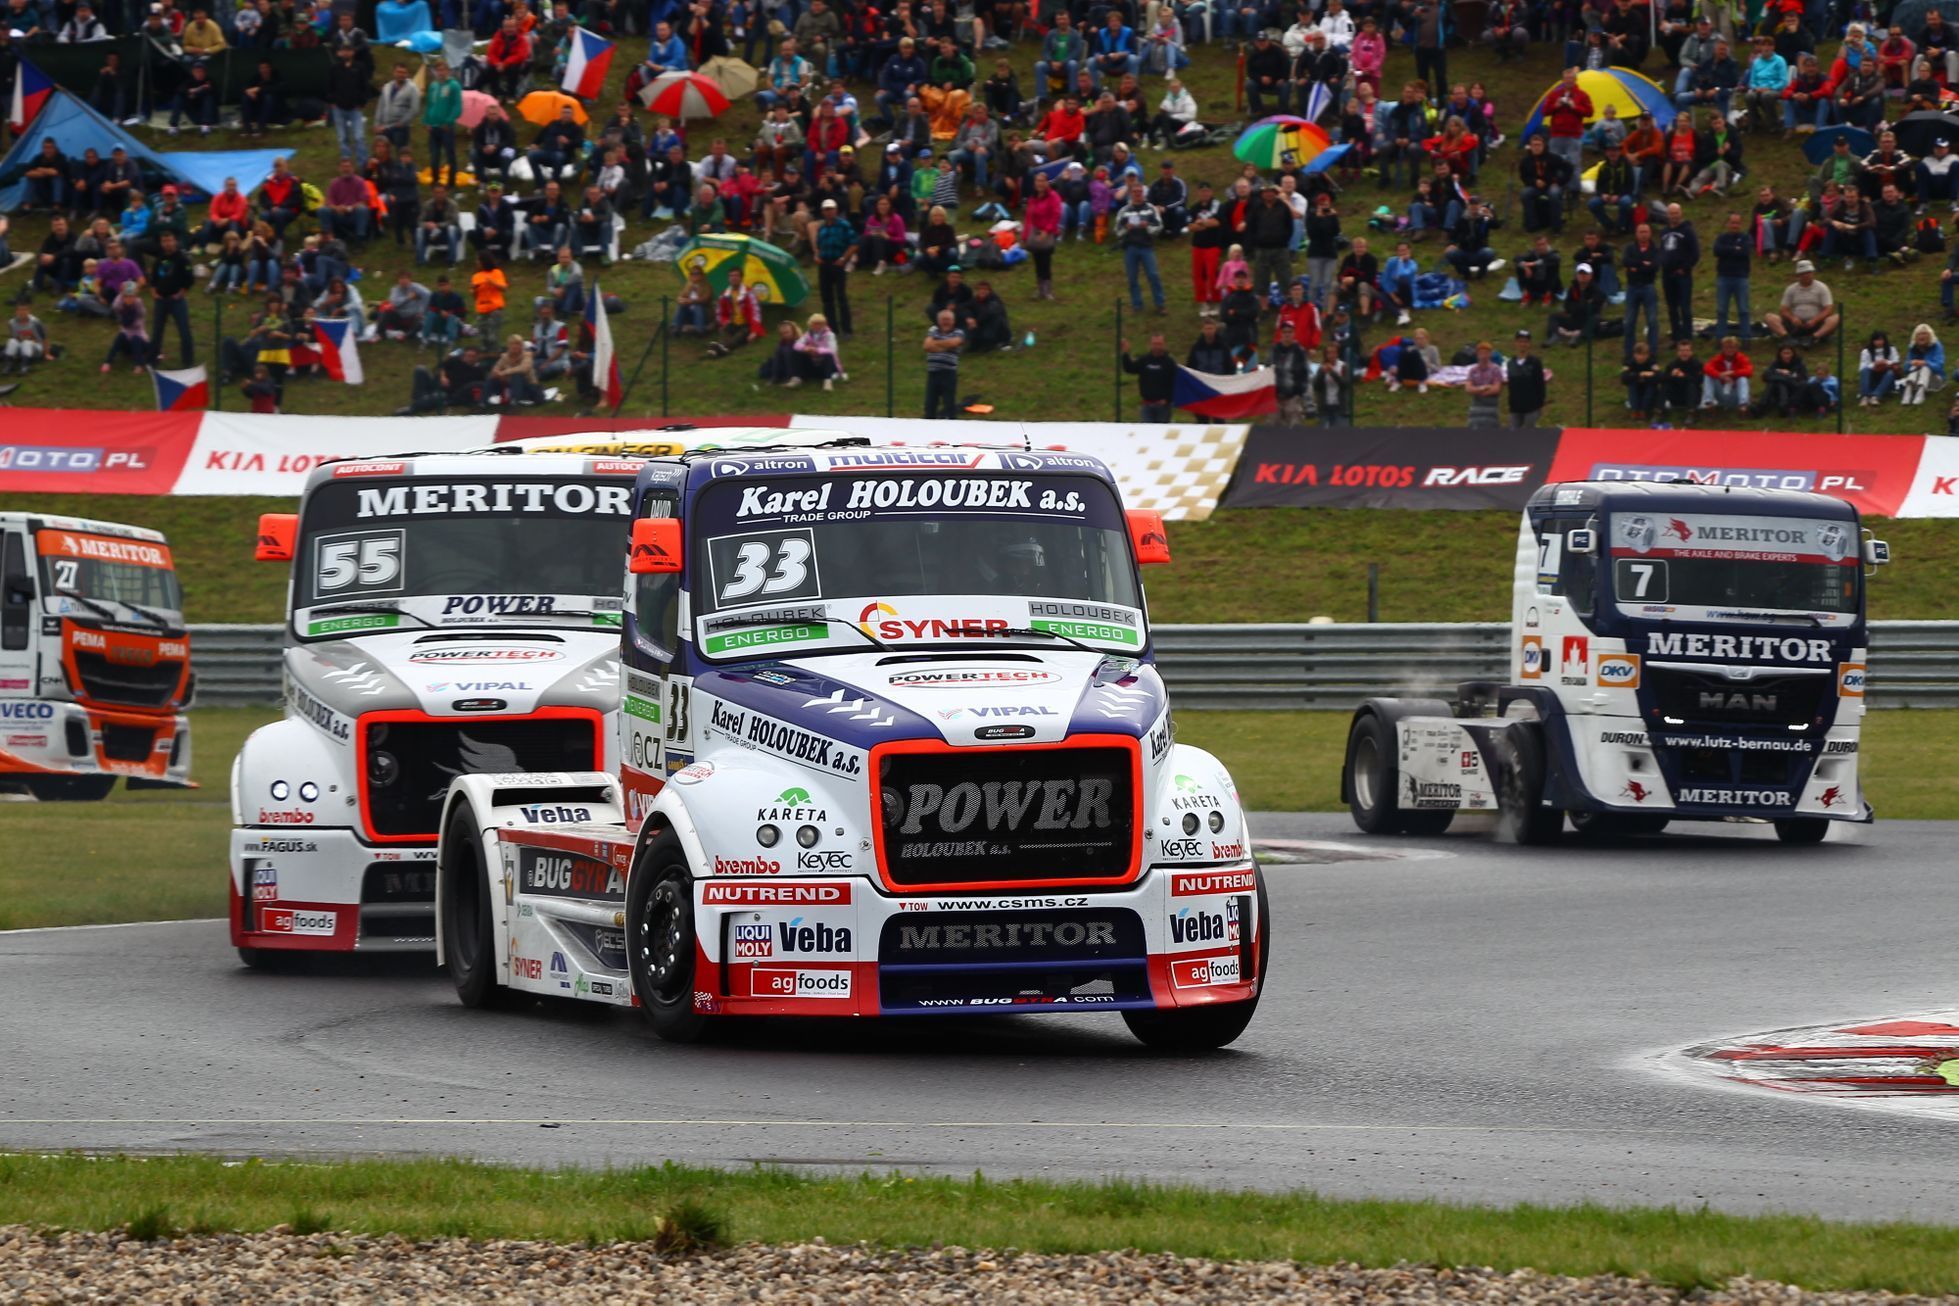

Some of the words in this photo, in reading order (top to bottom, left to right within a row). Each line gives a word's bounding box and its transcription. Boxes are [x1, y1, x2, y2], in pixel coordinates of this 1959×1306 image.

[206, 451, 264, 471] KIA
[753, 460, 808, 470] altron
[828, 452, 967, 466] multicar
[1046, 454, 1094, 467] altron
[335, 463, 404, 474] AUTOCONT
[1254, 463, 1319, 486] KIA
[1328, 465, 1416, 487] LOTOS
[1422, 466, 1531, 487] RACE
[357, 484, 632, 518] MERITOR
[736, 482, 832, 517] Karel
[846, 479, 1033, 509] HOLOUBEK
[1039, 490, 1086, 513] a.s.
[651, 500, 672, 519] DAVID
[783, 512, 824, 523] TRADE
[828, 510, 871, 521] GROUP
[1697, 526, 1805, 544] MERITOR
[79, 539, 164, 564] MERITOR
[1540, 538, 1550, 568] 7
[1674, 549, 1690, 557] THE
[1691, 550, 1711, 559] AXLE
[1713, 551, 1732, 559] AND
[1734, 552, 1760, 560] BRAKE
[1762, 553, 1797, 562] EXPERTS
[319, 537, 400, 590] 55
[721, 538, 811, 600] 33
[55, 560, 79, 589] 27
[1630, 564, 1653, 597] 7
[442, 595, 556, 615] POWER
[1031, 604, 1135, 624] HOLOUBEK
[321, 617, 386, 632] ENERGO
[879, 619, 1010, 640] SYNER
[1048, 623, 1124, 640] ENERGO
[73, 631, 106, 648] PEMA
[725, 627, 810, 648] ENERGO
[409, 650, 555, 661] POWERTECH
[1647, 633, 1832, 662] MERITOR
[888, 672, 1049, 685] POWERTECH
[1600, 664, 1634, 677] DKV
[456, 682, 533, 691] VIPAL
[1699, 692, 1777, 711] MAN
[666, 681, 689, 743] 33
[968, 706, 1059, 718] VIPAL
[711, 699, 745, 735] Karel
[748, 716, 833, 765] HOLOUBEK
[832, 751, 861, 775] a.s.
[1601, 732, 1644, 745] DURON
[1665, 735, 1811, 752] www.lutz-bernau.de
[1172, 795, 1221, 811] KARETA
[1679, 789, 1791, 805] MERITOR
[757, 808, 827, 821] KARETA
[901, 778, 1113, 835] POWER
[259, 808, 314, 824] brembo
[1161, 839, 1203, 861] KeyTec
[715, 855, 780, 875] brembo
[797, 851, 852, 873] KeyTec
[534, 857, 625, 894] BUGGYRA
[1179, 874, 1254, 891] NUTREND
[708, 887, 840, 900] NUTREND
[908, 902, 928, 911] TOW
[937, 897, 1088, 911] www.csms.cz
[736, 926, 770, 940] LIQUI
[900, 922, 1117, 950] MERITOR
[736, 942, 771, 956] MOLY
[515, 957, 542, 980] SYNER
